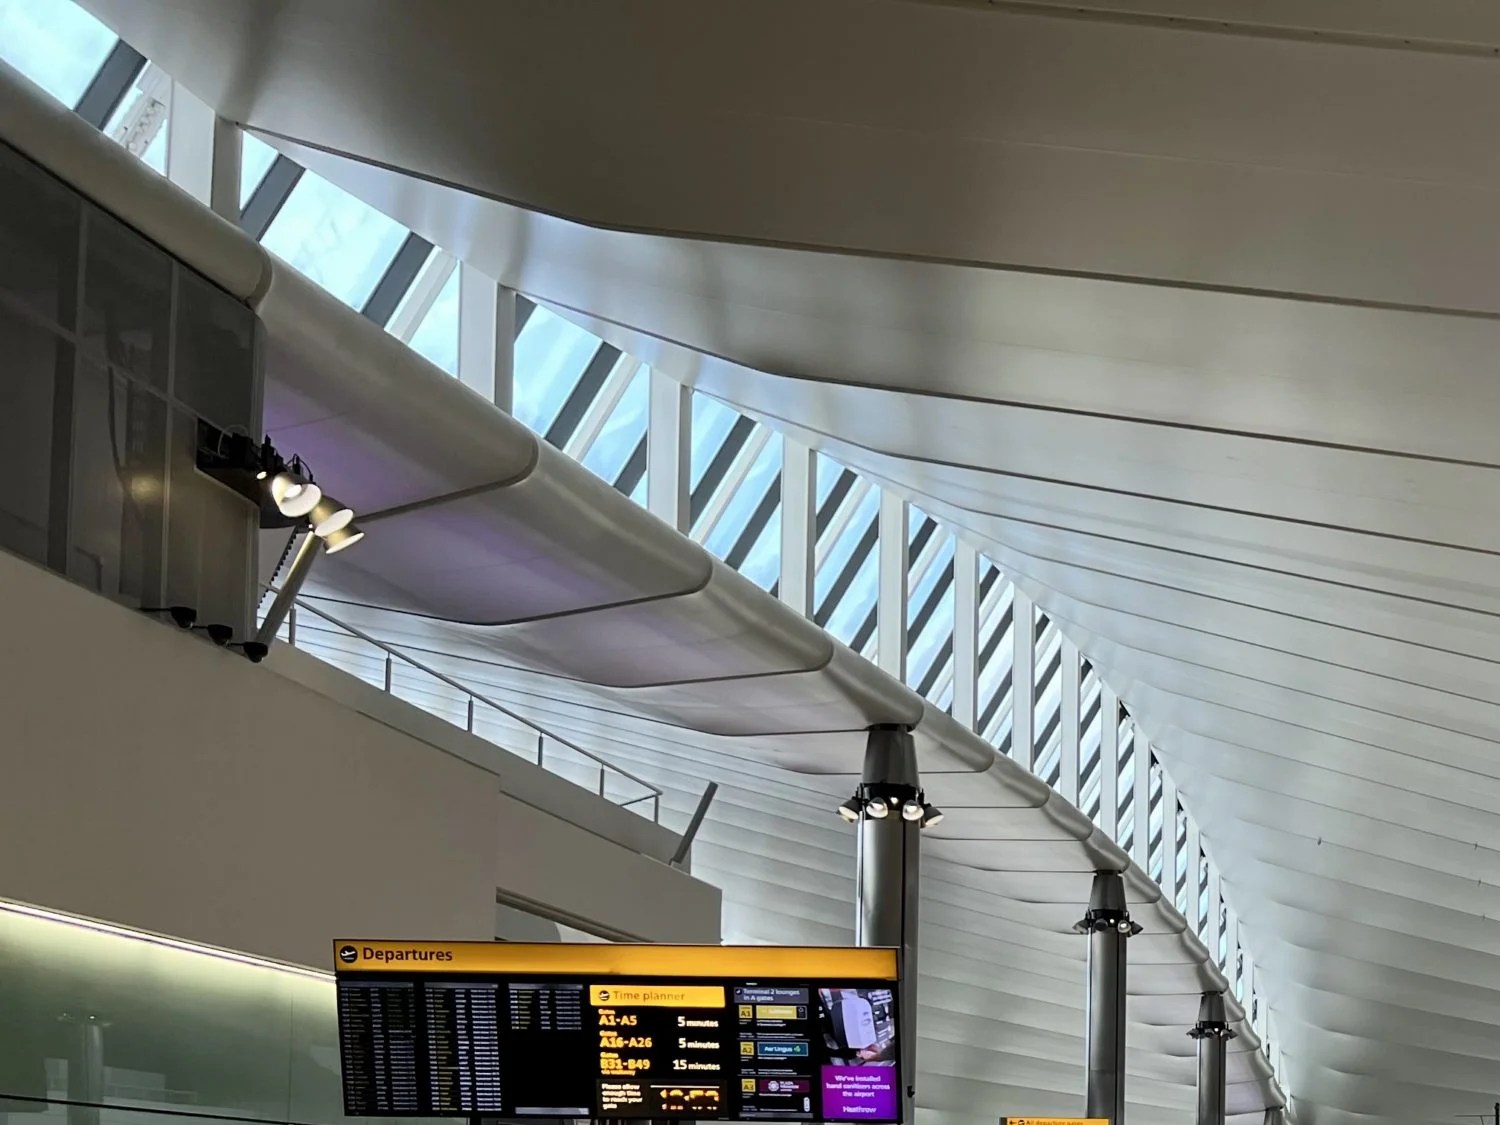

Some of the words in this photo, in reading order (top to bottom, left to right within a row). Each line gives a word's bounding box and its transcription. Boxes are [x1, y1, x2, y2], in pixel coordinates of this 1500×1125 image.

[362, 947, 453, 963] Departures
[614, 991, 640, 1000] Time
[643, 992, 685, 1001] planner
[599, 1015, 637, 1025] A1-A5
[677, 1016, 686, 1027] 5
[600, 1037, 652, 1048] A16-A26
[678, 1038, 686, 1048] 5
[687, 1041, 720, 1049] minutes
[672, 1060, 687, 1070] 15
[688, 1062, 720, 1070] minutes
